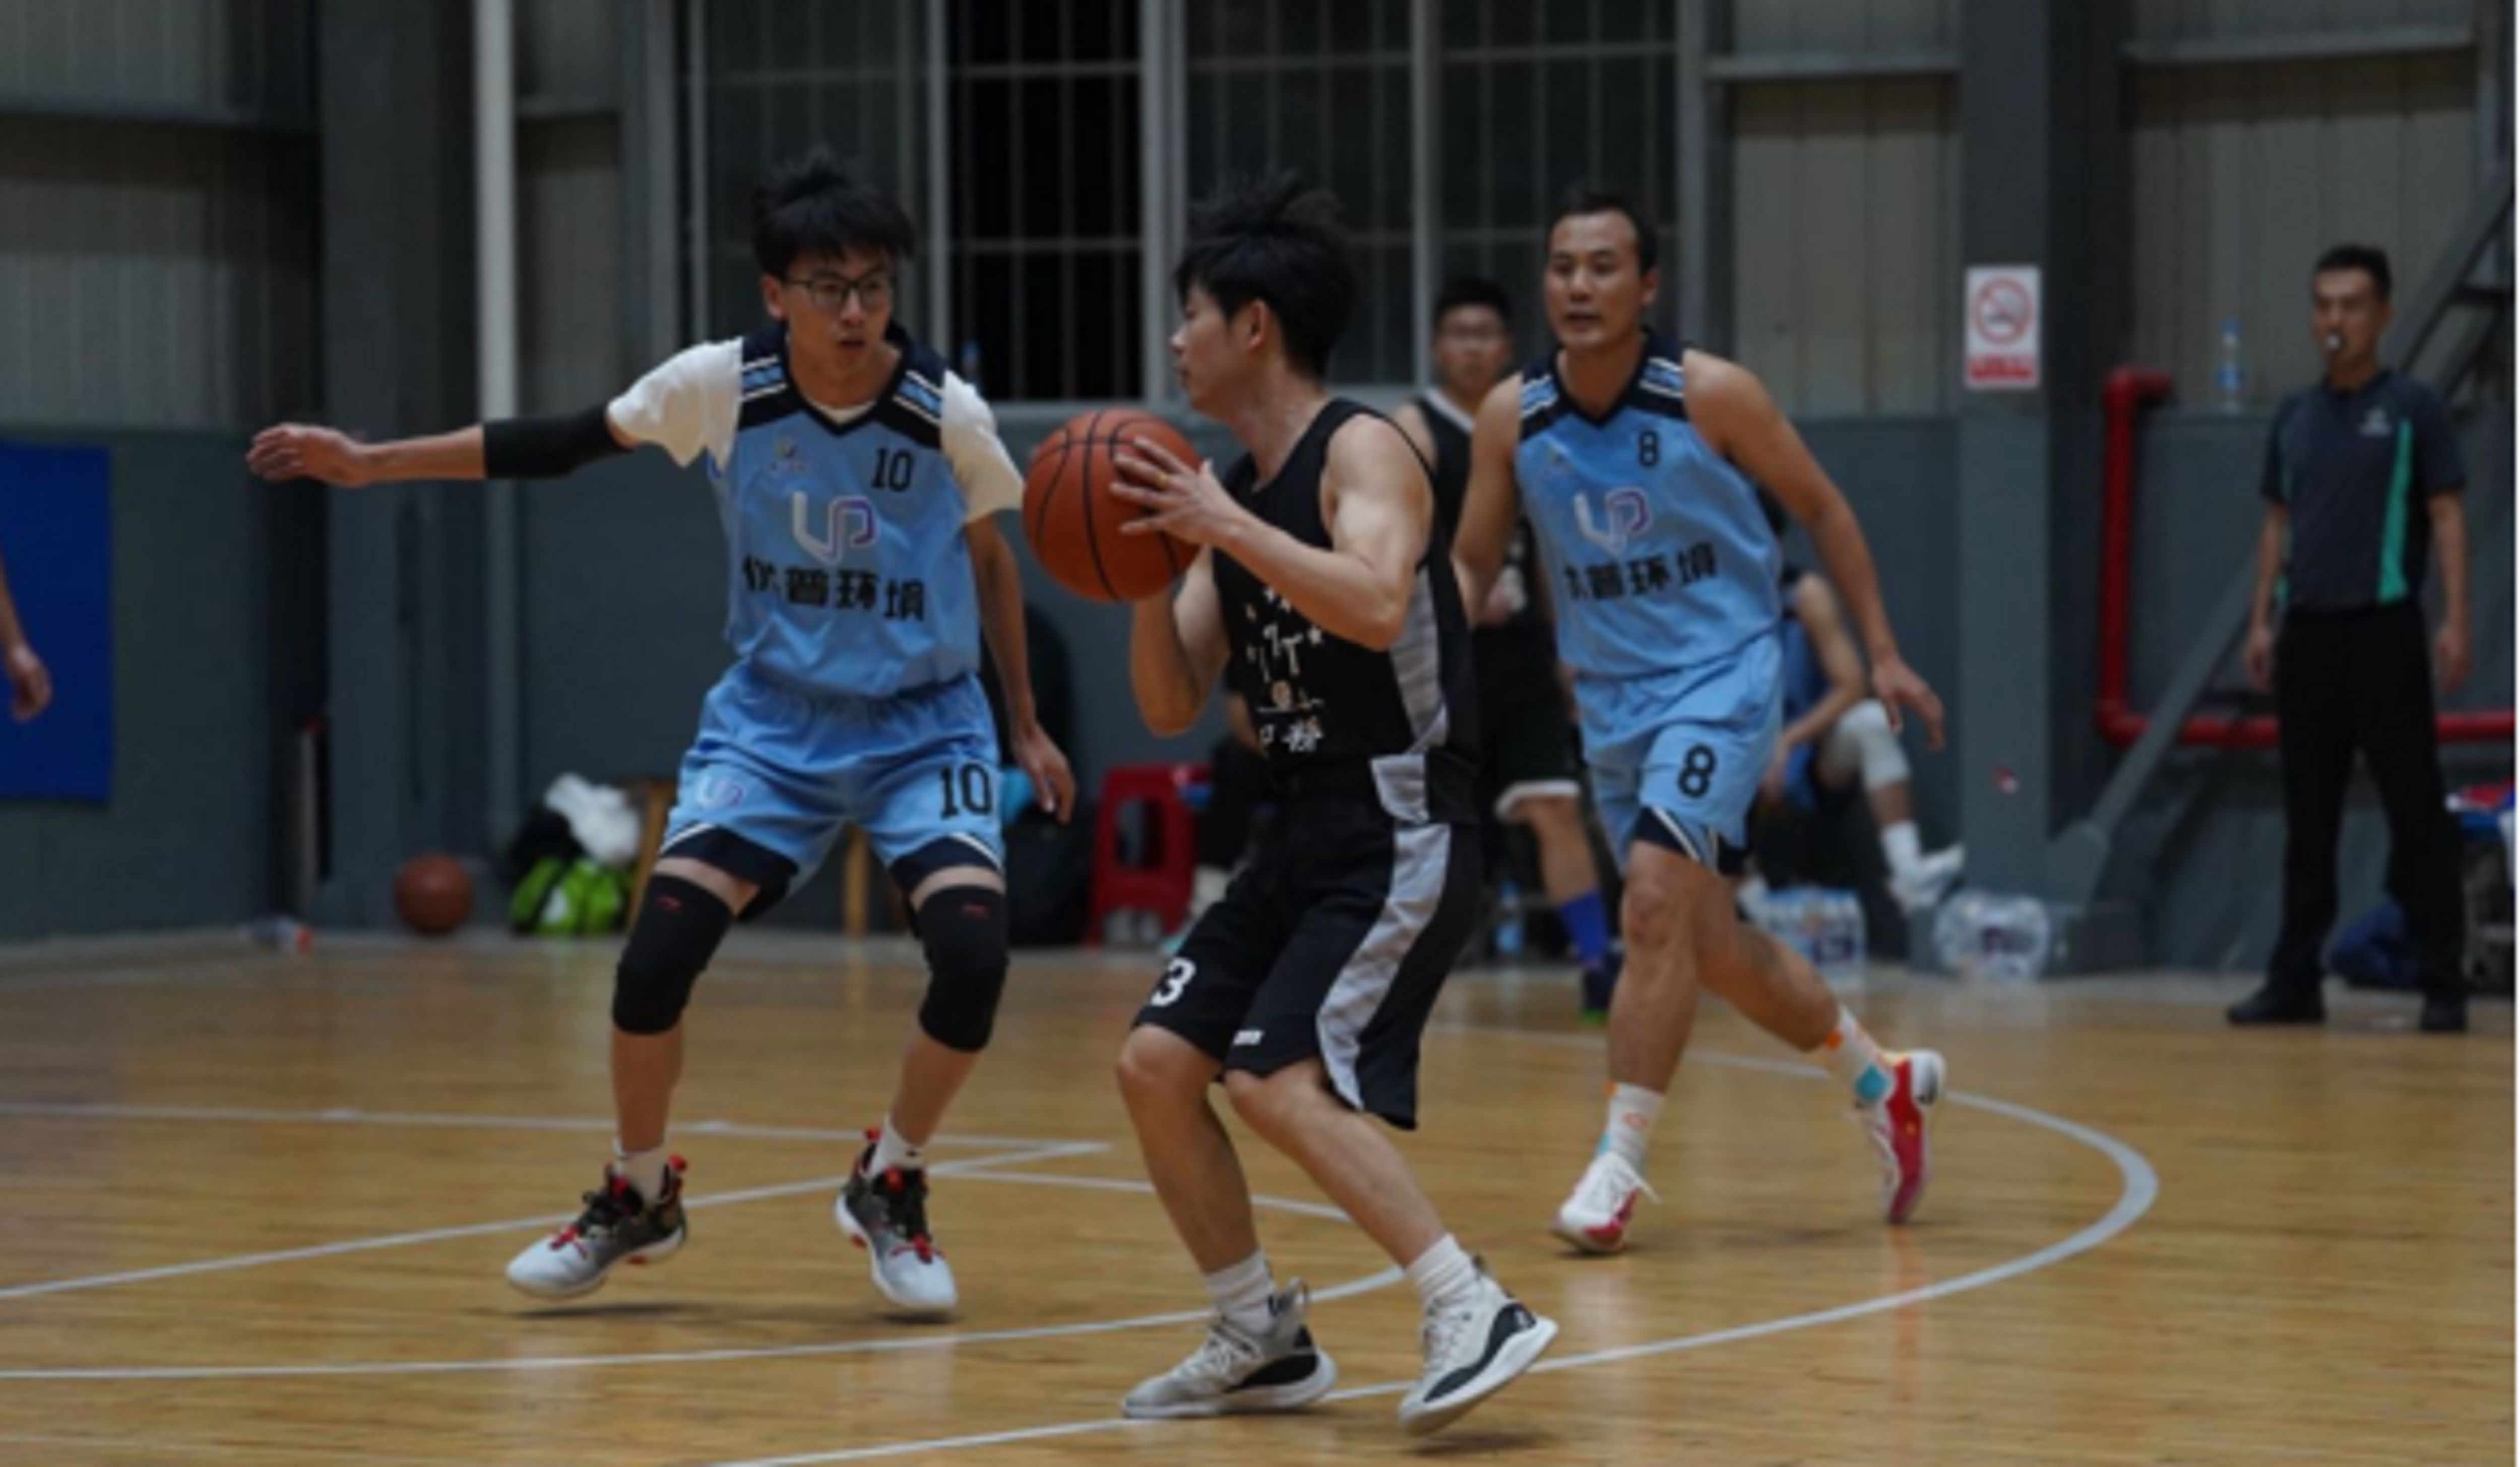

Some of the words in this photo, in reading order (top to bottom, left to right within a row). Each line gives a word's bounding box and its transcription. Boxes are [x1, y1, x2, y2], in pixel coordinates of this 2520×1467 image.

[871, 448, 915, 492] 10
[1639, 431, 1659, 466] 8
[940, 763, 992, 819] 10
[1678, 743, 1716, 798] 8
[1150, 957, 1196, 1006] 3
